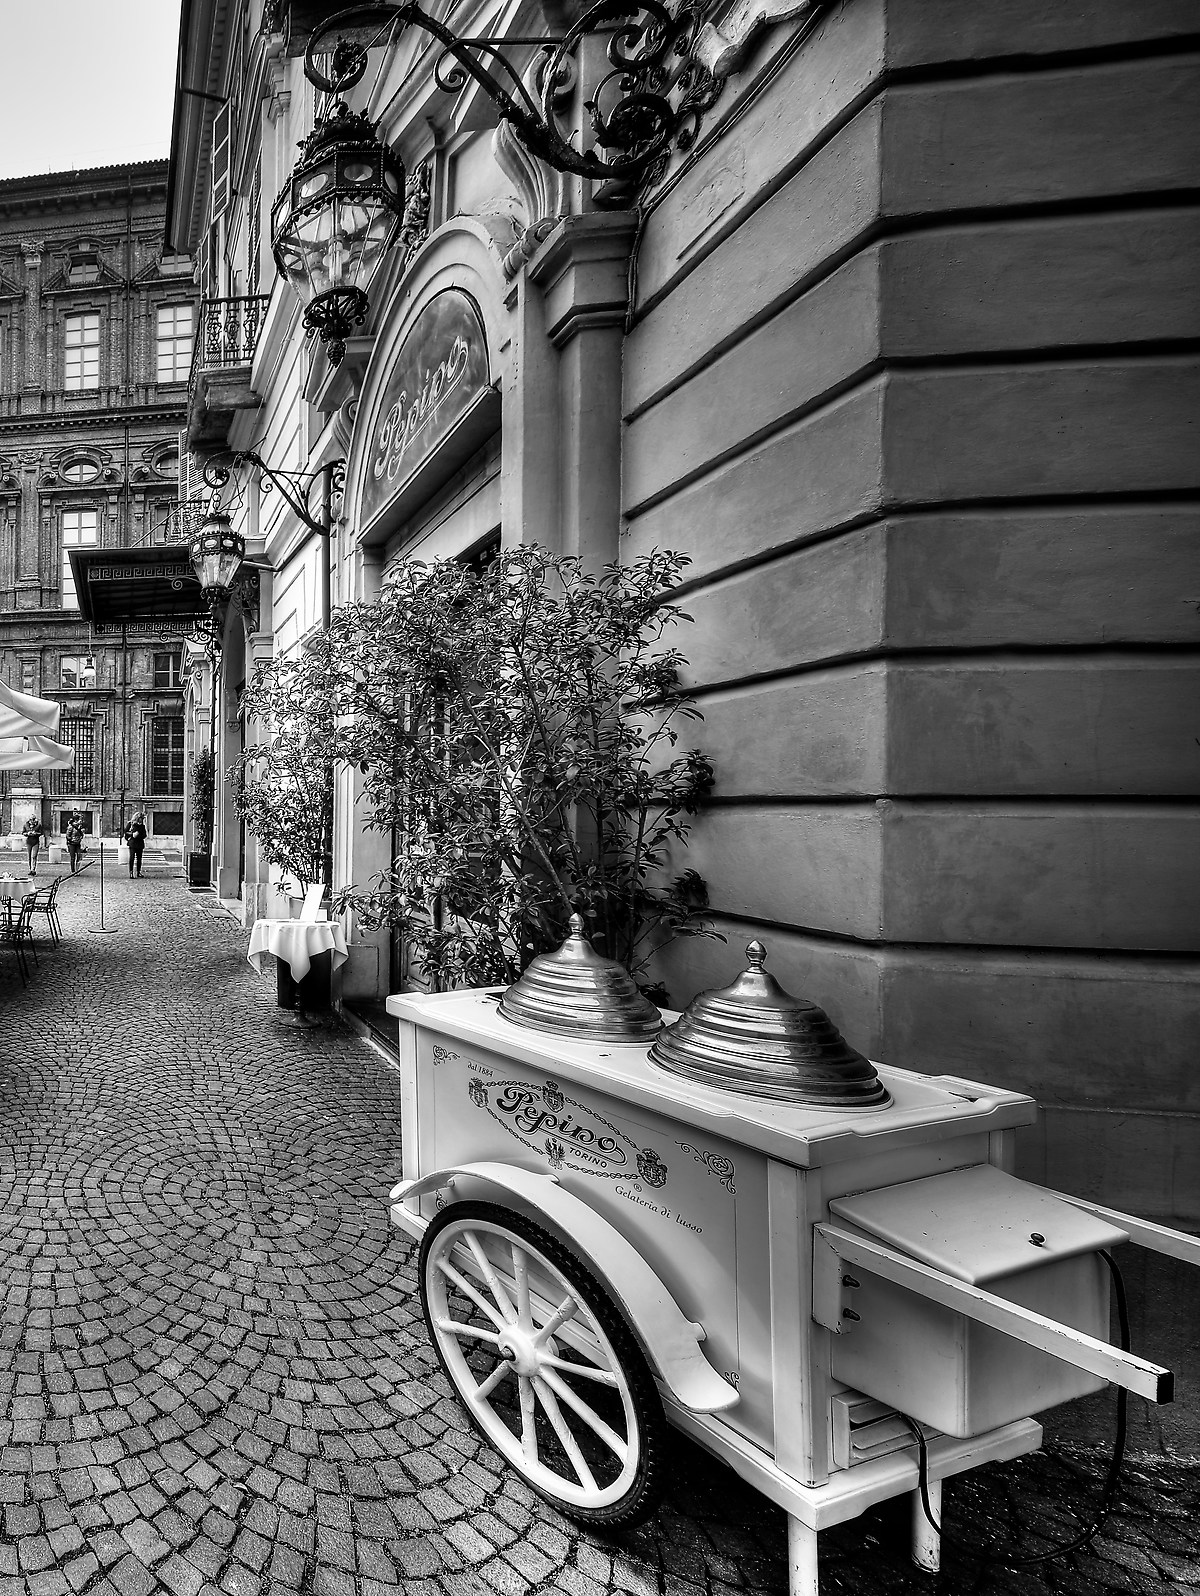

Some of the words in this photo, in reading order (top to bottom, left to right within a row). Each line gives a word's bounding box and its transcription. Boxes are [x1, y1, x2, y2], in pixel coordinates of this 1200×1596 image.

[374, 335, 469, 482] Pepino
[467, 1061, 478, 1072] dal
[496, 1086, 627, 1166] Pepino
[569, 1146, 608, 1168] TORINO
[615, 1185, 658, 1213] Gelateria
[660, 1205, 672, 1219] di
